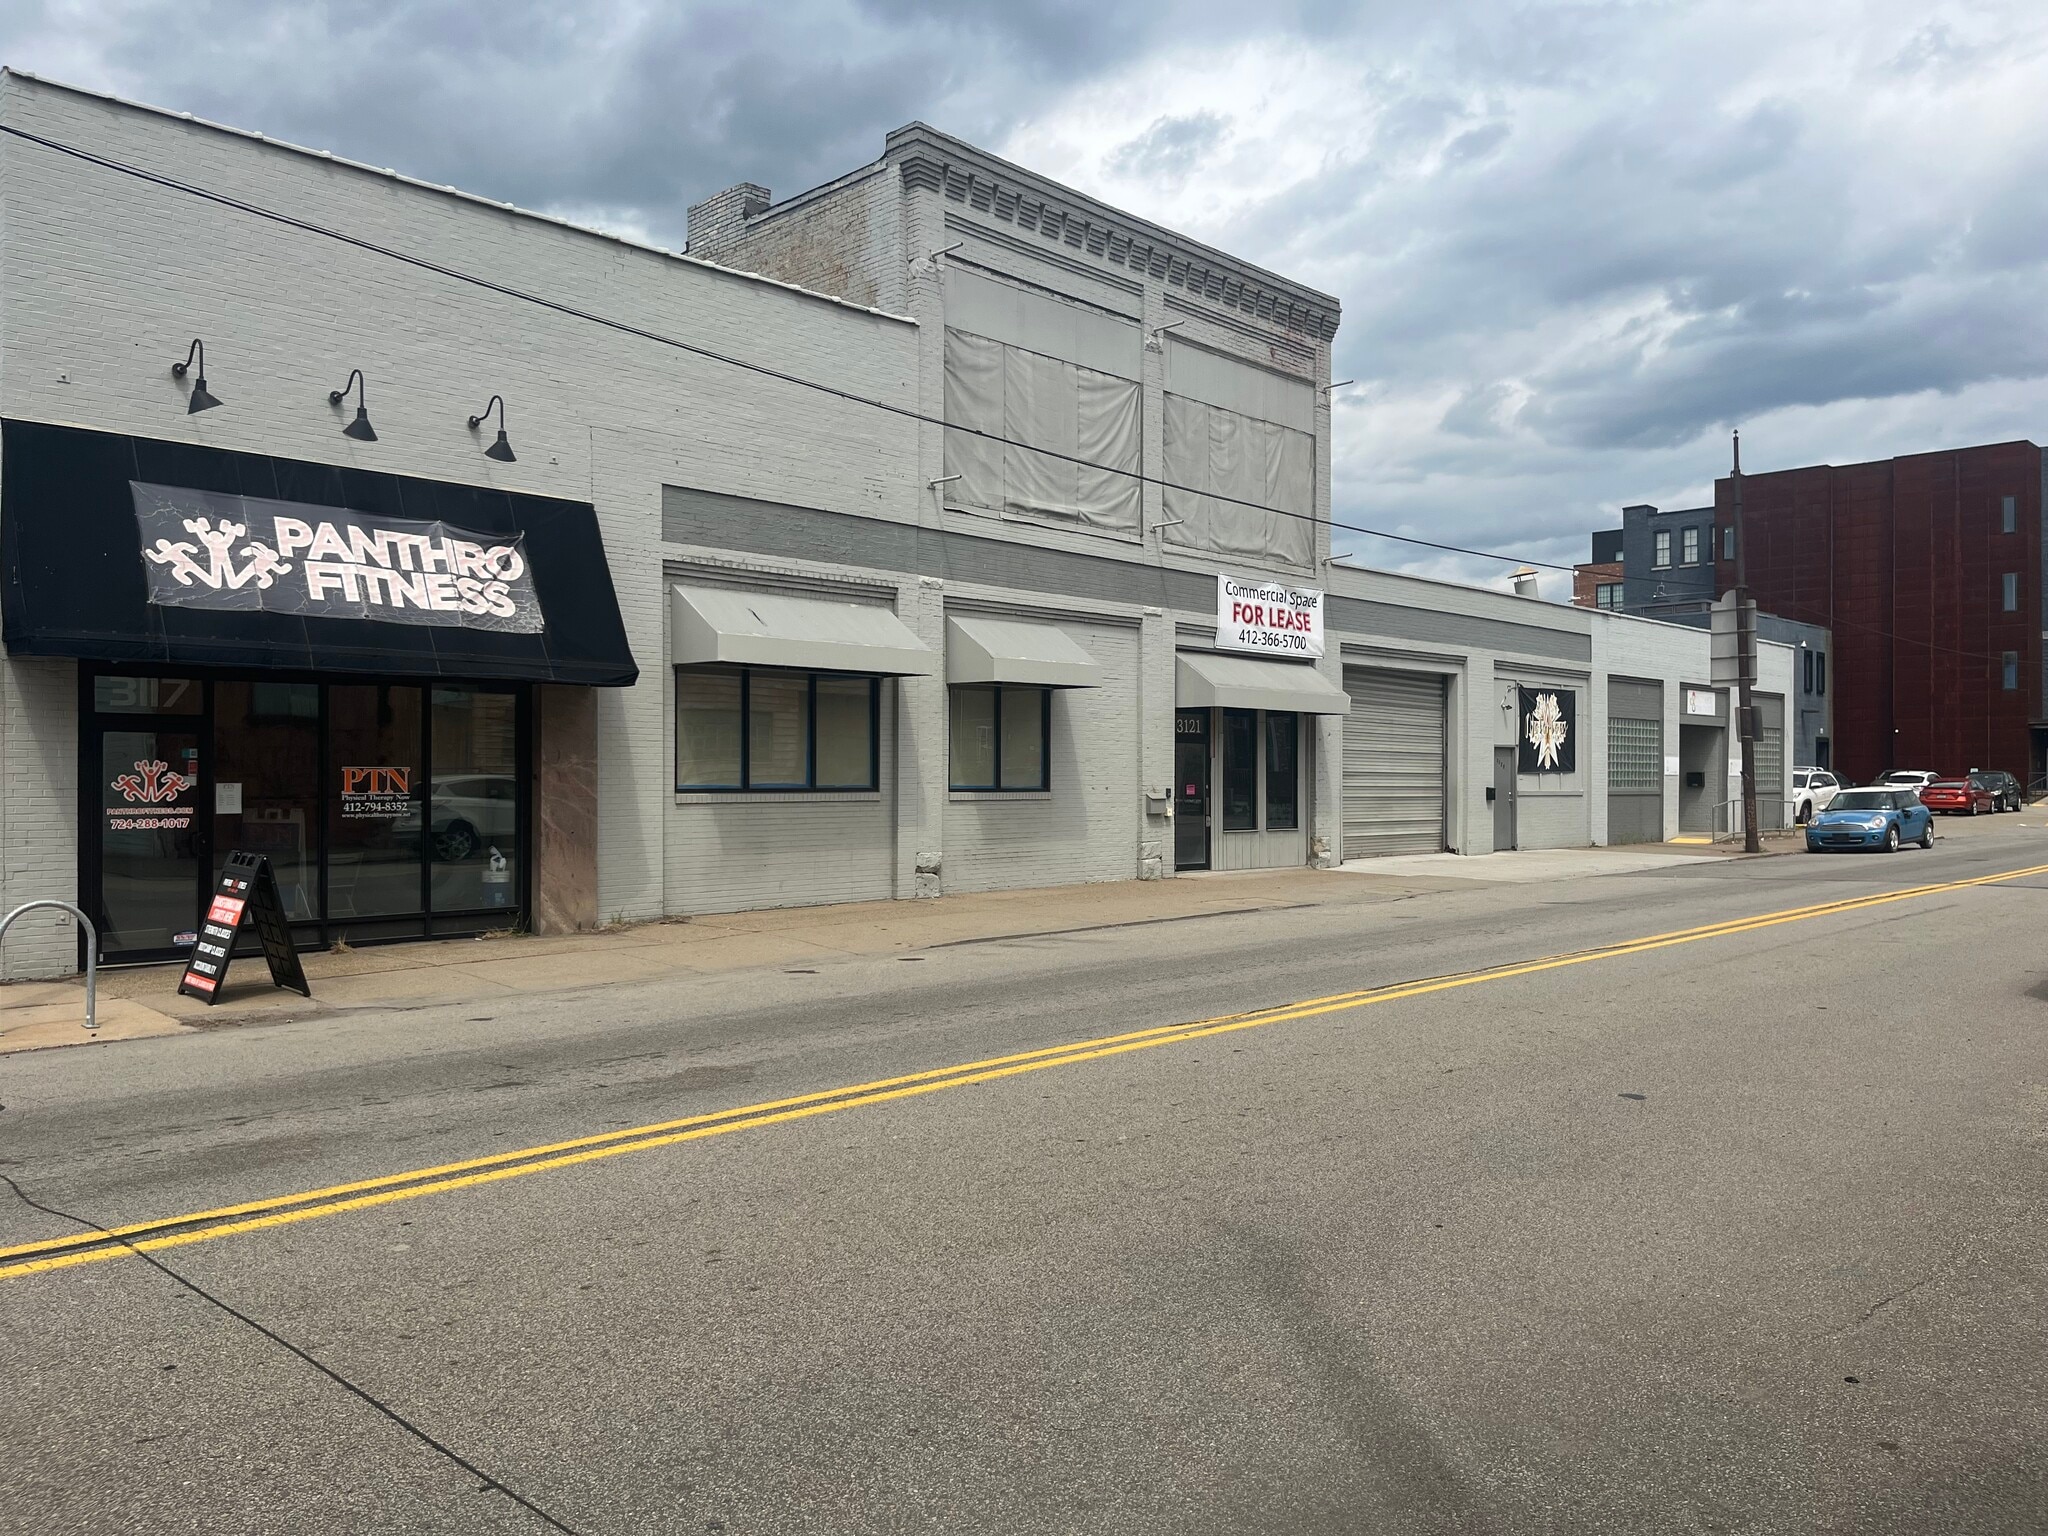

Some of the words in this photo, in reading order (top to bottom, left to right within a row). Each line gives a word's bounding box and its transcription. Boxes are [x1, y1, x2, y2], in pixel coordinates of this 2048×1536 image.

[273, 516, 525, 582] PANTHRO
[304, 560, 516, 617] FITNESS
[1225, 581, 1287, 603] Commercial
[1289, 592, 1318, 609] Space
[1232, 601, 1265, 627] FOR
[1269, 607, 1312, 633] LEASE
[1238, 629, 1307, 650] 412-366-5700
[109, 676, 190, 707] 3117
[1176, 719, 1201, 733] 3121
[341, 767, 410, 794] PTN
[343, 802, 408, 812] 412-794-8352
[110, 818, 190, 830] 724-288-1017
